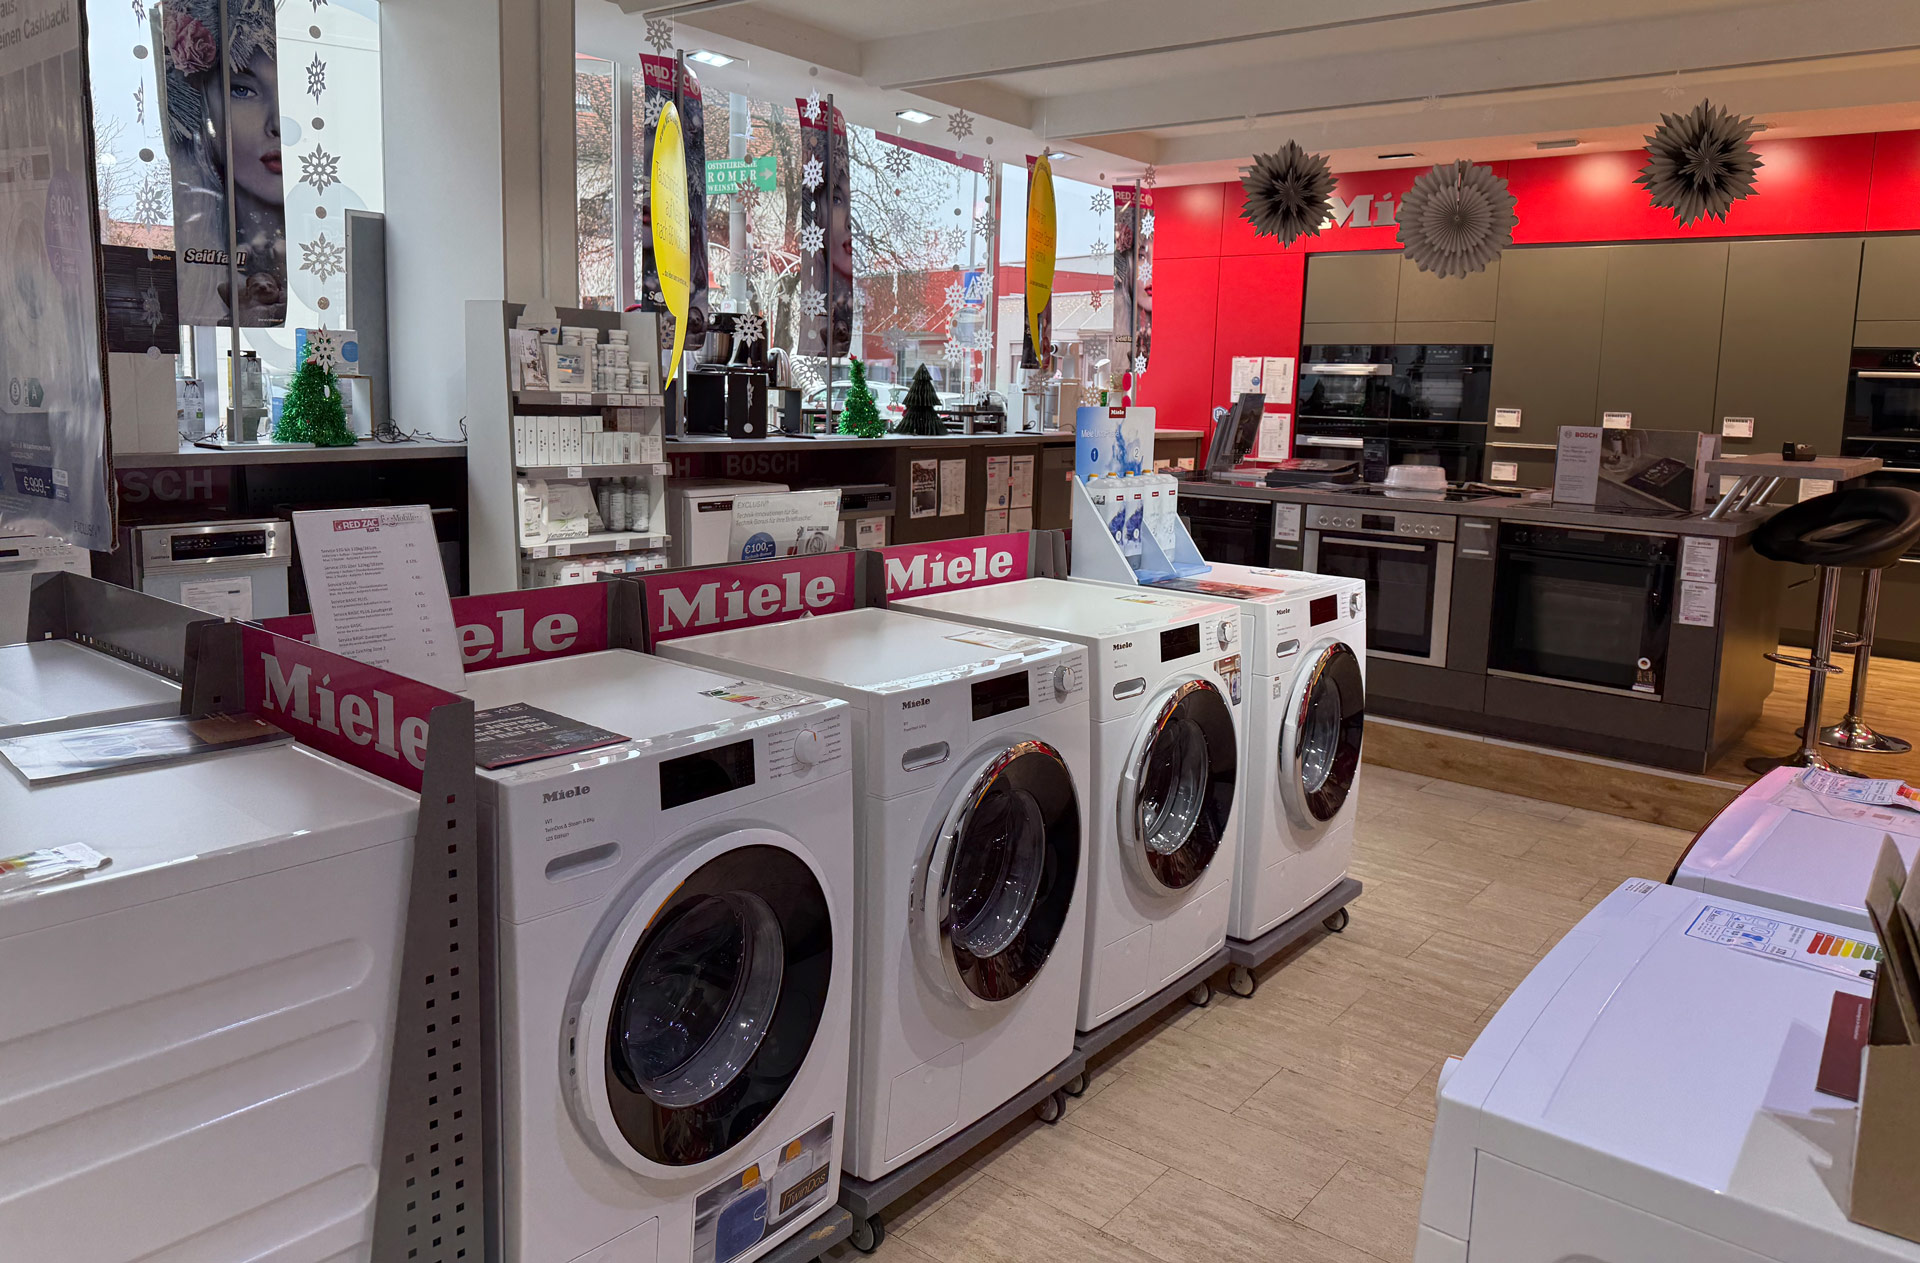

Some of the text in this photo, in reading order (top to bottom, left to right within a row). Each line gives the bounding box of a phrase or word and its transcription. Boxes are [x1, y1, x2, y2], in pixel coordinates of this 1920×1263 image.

[23, 3, 70, 39] Cashback!
[671, 70, 691, 88] ZC
[1114, 190, 1146, 202] RED ZC
[184, 248, 247, 266] Seid fal!
[727, 453, 800, 477] BOSCH
[122, 469, 213, 503] SCH
[343, 520, 360, 530] RED
[362, 519, 378, 528] ZAC
[885, 547, 1014, 595] Miele
[658, 571, 835, 632] Miele
[1276, 607, 1291, 616] Miele
[461, 608, 579, 666] ele
[1112, 640, 1133, 651] Miele
[260, 650, 431, 772] Miele
[901, 697, 931, 711] Miele
[474, 728, 503, 738] ack
[542, 785, 591, 804] Miele
[545, 824, 564, 833] TwinDos
[786, 1172, 827, 1208] TwinDos
